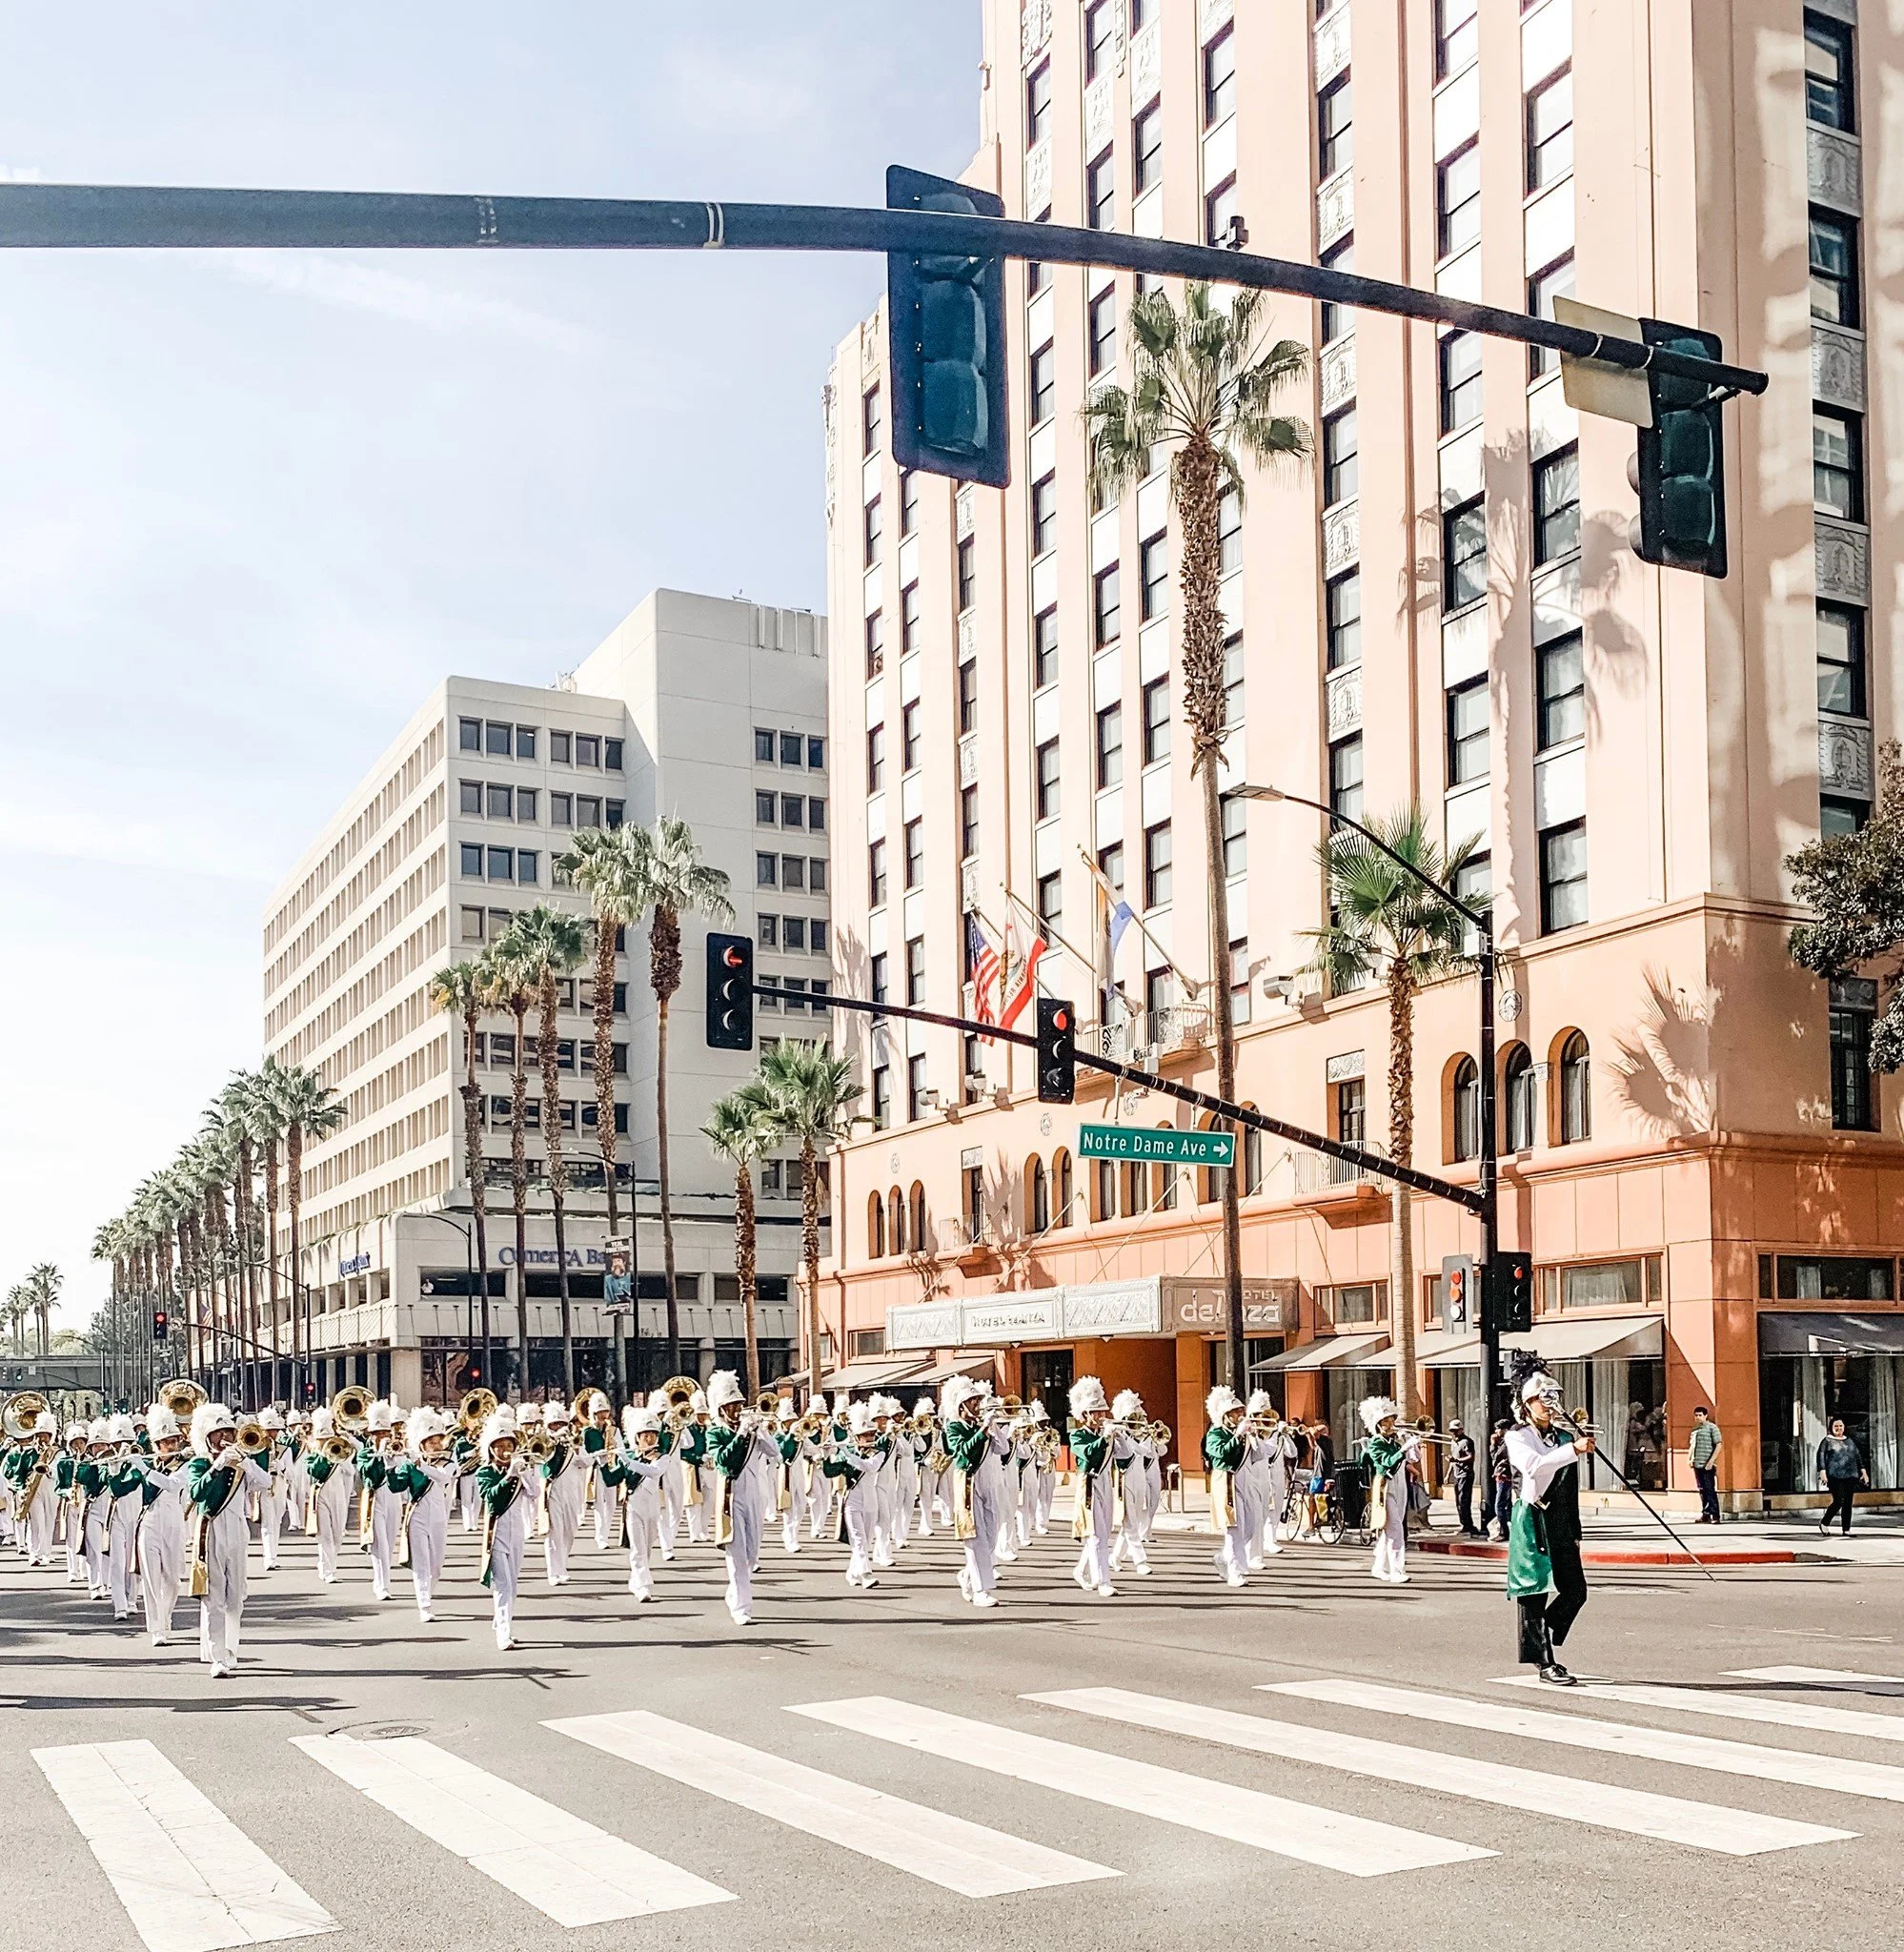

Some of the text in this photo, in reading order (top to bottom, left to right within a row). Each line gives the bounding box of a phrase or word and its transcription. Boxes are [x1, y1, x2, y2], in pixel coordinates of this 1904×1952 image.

[1084, 1131, 1206, 1156] Notre Dame Ave
